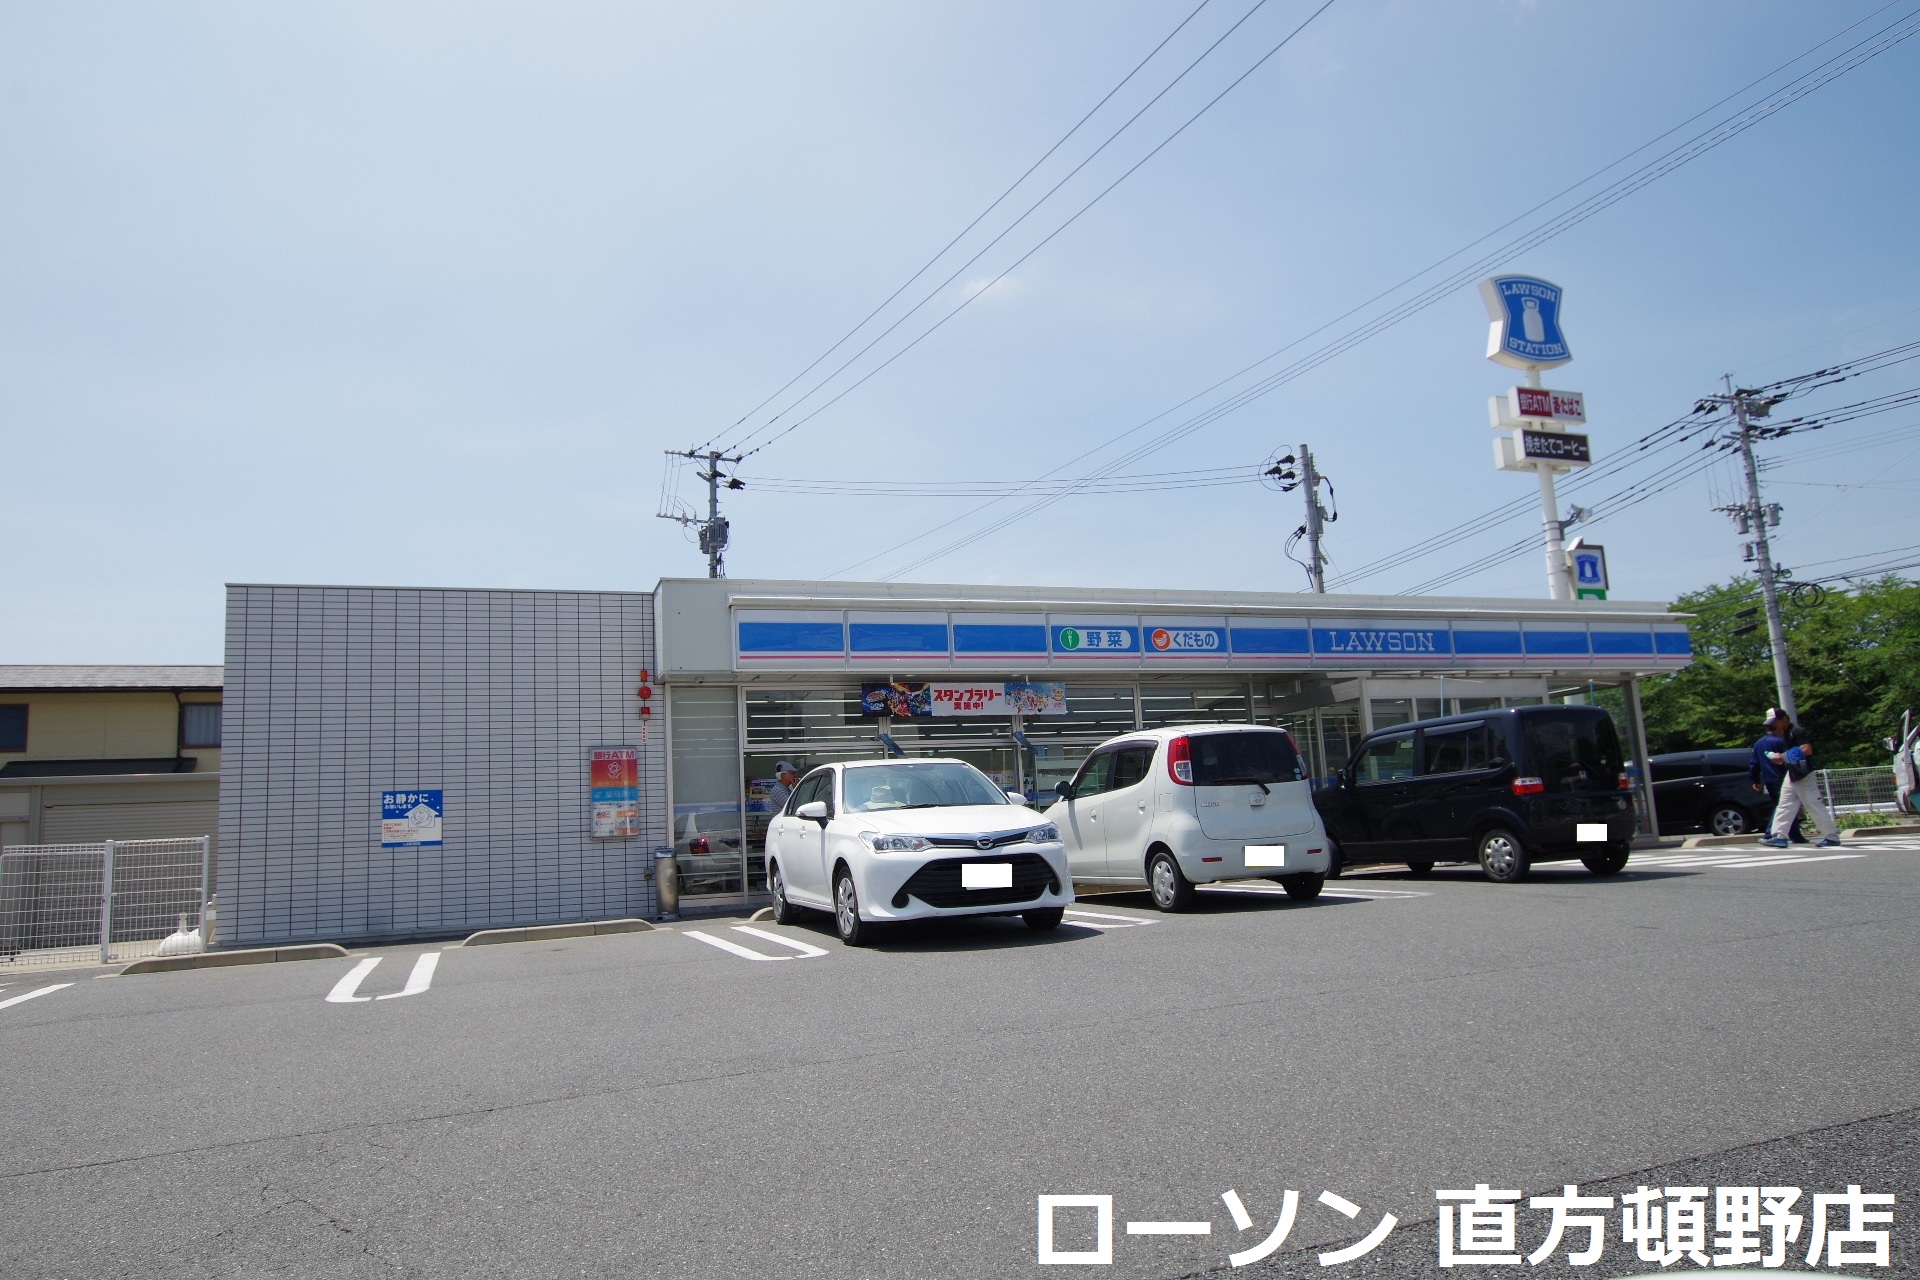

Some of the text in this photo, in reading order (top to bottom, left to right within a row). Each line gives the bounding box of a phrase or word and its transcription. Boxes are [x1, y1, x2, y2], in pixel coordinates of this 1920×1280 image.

[1502, 284, 1556, 302] LAWSON
[1509, 337, 1564, 355] STATION
[1086, 631, 1123, 648] 野菜
[1173, 632, 1215, 648] くだもの
[1329, 631, 1436, 652] LAWSON
[933, 687, 1003, 702] スタンプラリー
[593, 750, 635, 760] 銀行ATM
[383, 793, 429, 804] お静かに
